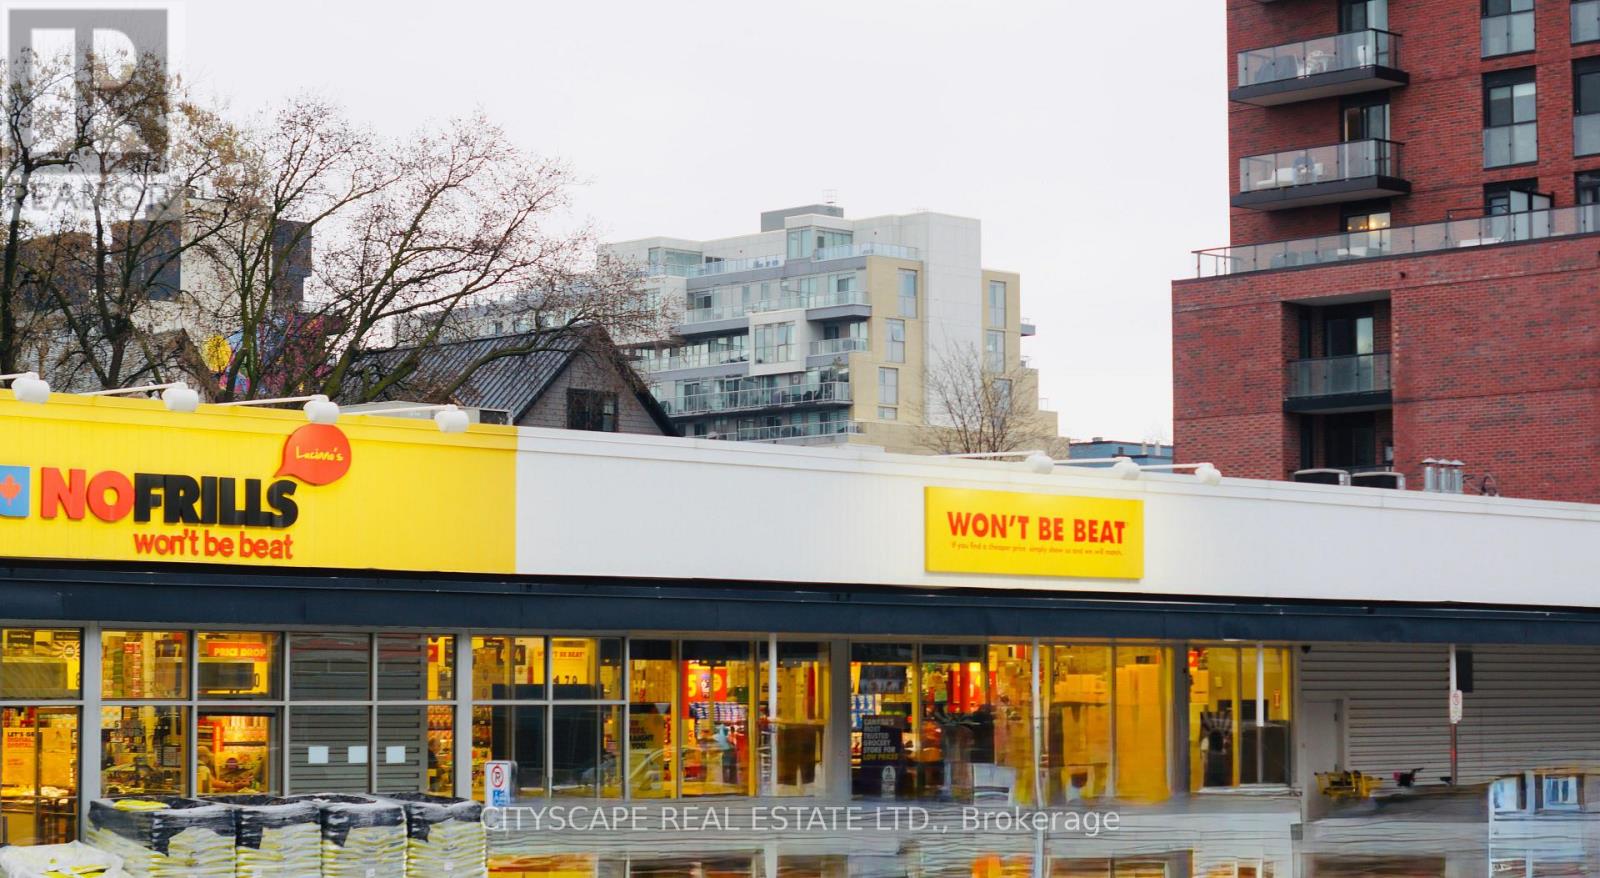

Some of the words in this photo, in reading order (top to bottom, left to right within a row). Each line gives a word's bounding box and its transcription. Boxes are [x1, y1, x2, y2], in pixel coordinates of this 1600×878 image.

[947, 512, 1029, 539] WON'T
[1039, 517, 1064, 541] BE
[1074, 519, 1126, 544] BEAT
[134, 529, 198, 555] won't
[205, 531, 233, 556] be
[239, 532, 294, 559] beat
[214, 648, 239, 656] PRICE
[240, 648, 266, 657] DROP
